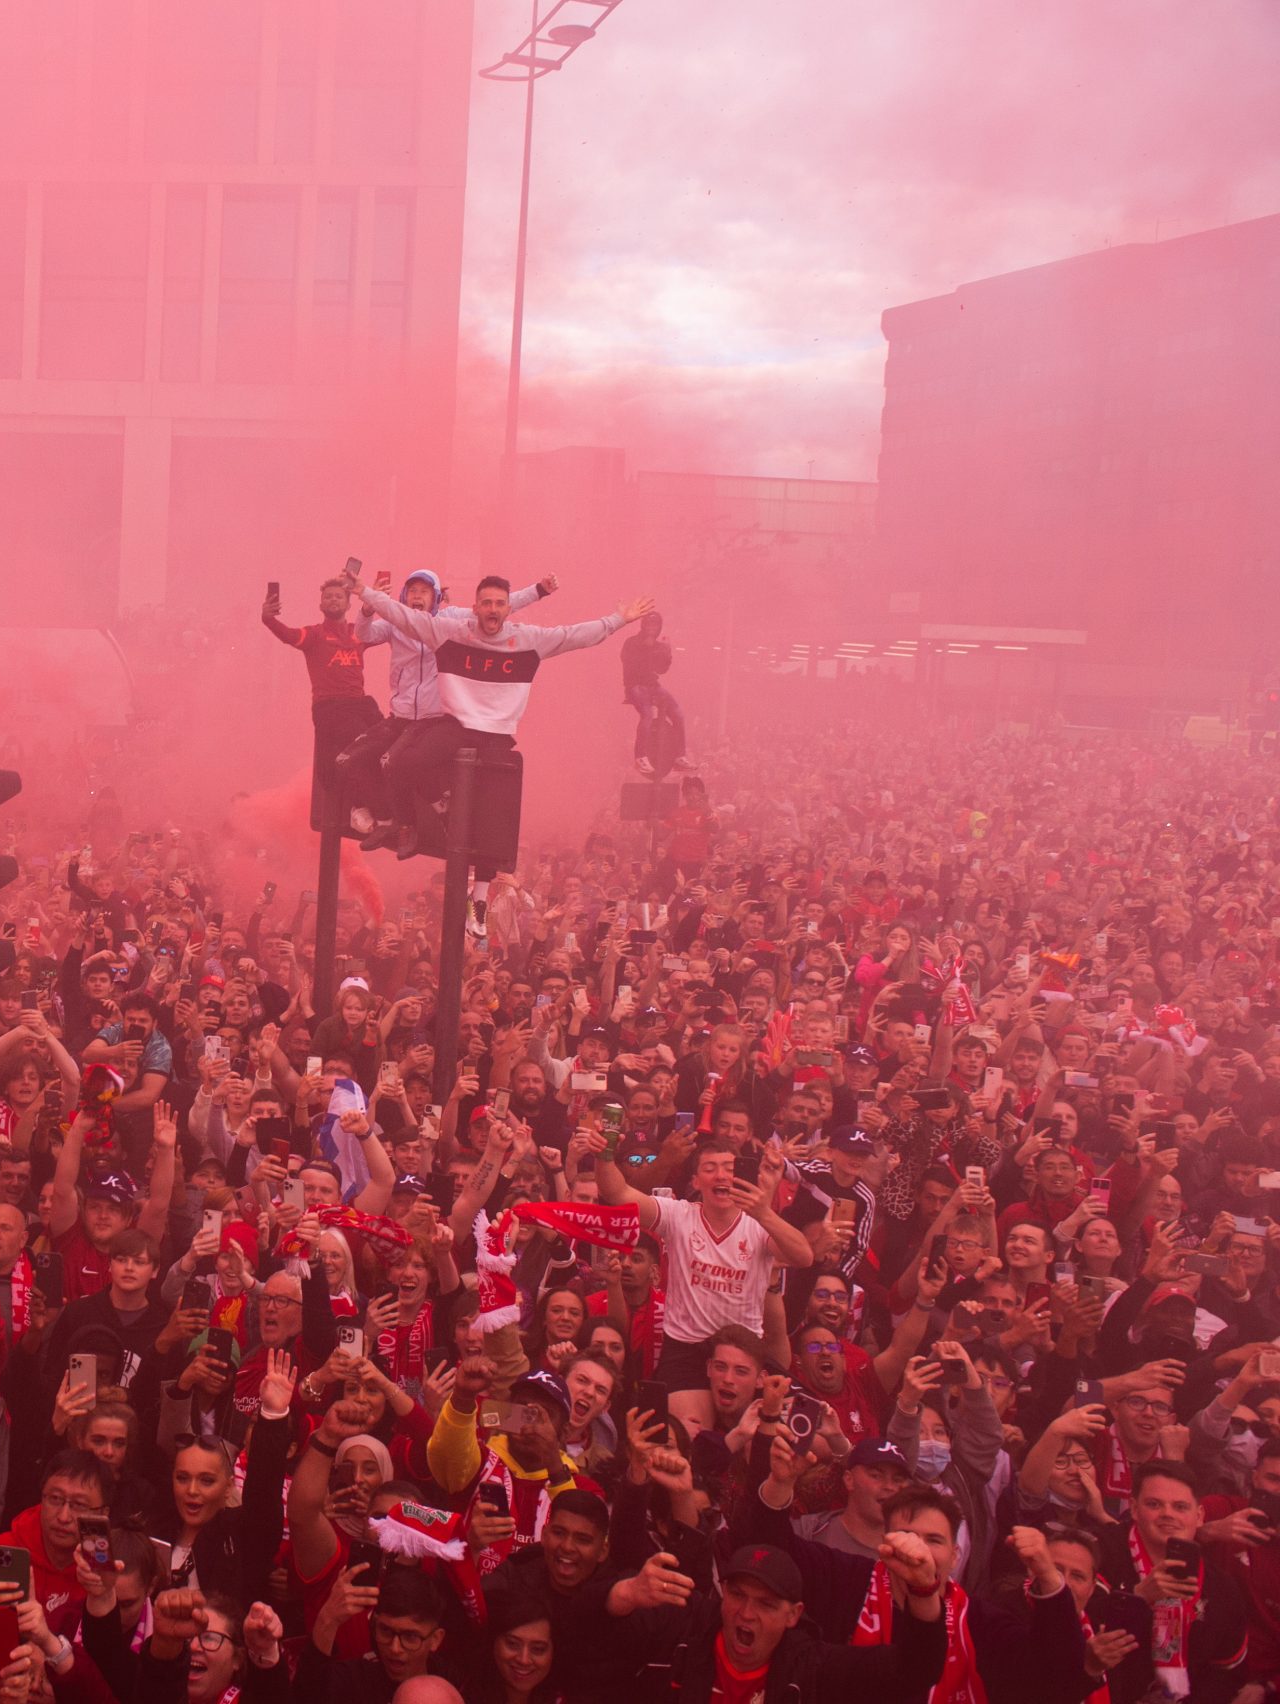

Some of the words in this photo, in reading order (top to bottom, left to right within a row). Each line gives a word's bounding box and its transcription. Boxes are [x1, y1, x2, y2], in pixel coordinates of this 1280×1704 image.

[327, 648, 362, 667] AXA
[690, 1260, 747, 1281] crown
[690, 1276, 743, 1296] paints
